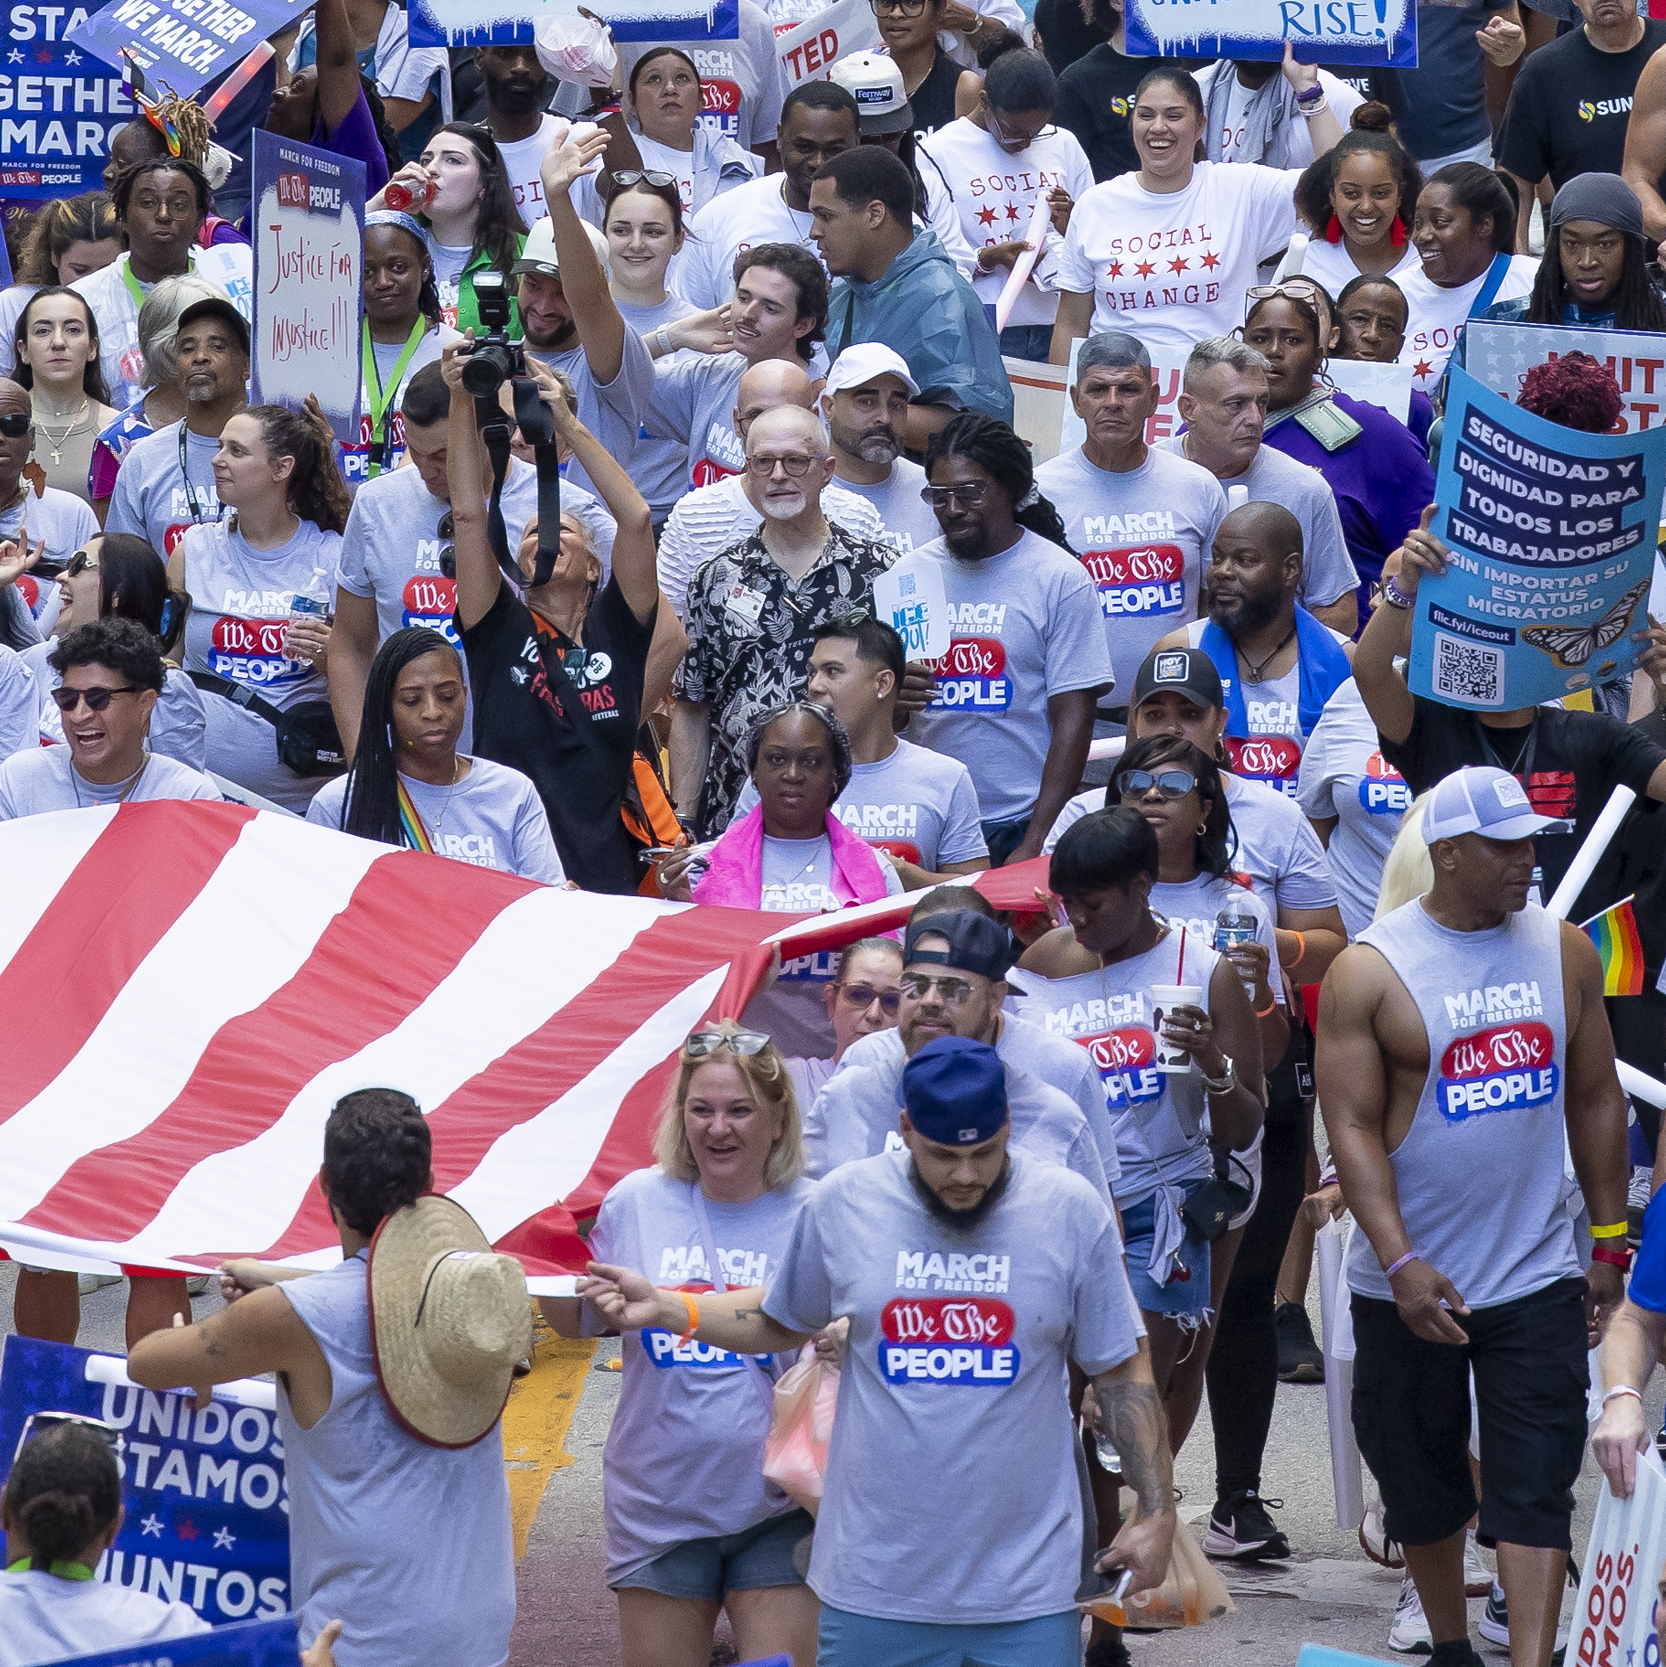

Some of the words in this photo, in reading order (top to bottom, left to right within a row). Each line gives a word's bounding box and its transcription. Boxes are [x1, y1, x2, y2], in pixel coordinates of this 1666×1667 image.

[1468, 416, 1609, 481] SEGURIDAD
[1617, 461, 1636, 478] Y
[1459, 451, 1564, 506] DIGNIDAD
[1571, 486, 1639, 508] PARA
[1467, 487, 1552, 534] TODOS
[1560, 518, 1614, 536] LOS
[1452, 518, 1639, 561] TRABAJADORES
[1450, 551, 1479, 575] SIN
[1485, 567, 1598, 589] IMPORTAR
[1604, 561, 1629, 579] SU
[1468, 595, 1605, 620] MIGRATORIO
[1491, 586, 1589, 604] ESTATUS
[1434, 609, 1510, 642] flic.fyi/iceout
[896, 1251, 1010, 1281] MARCH
[892, 1304, 939, 1343] We
[942, 1302, 1003, 1342] The
[887, 1348, 1013, 1378] PEOPLE
